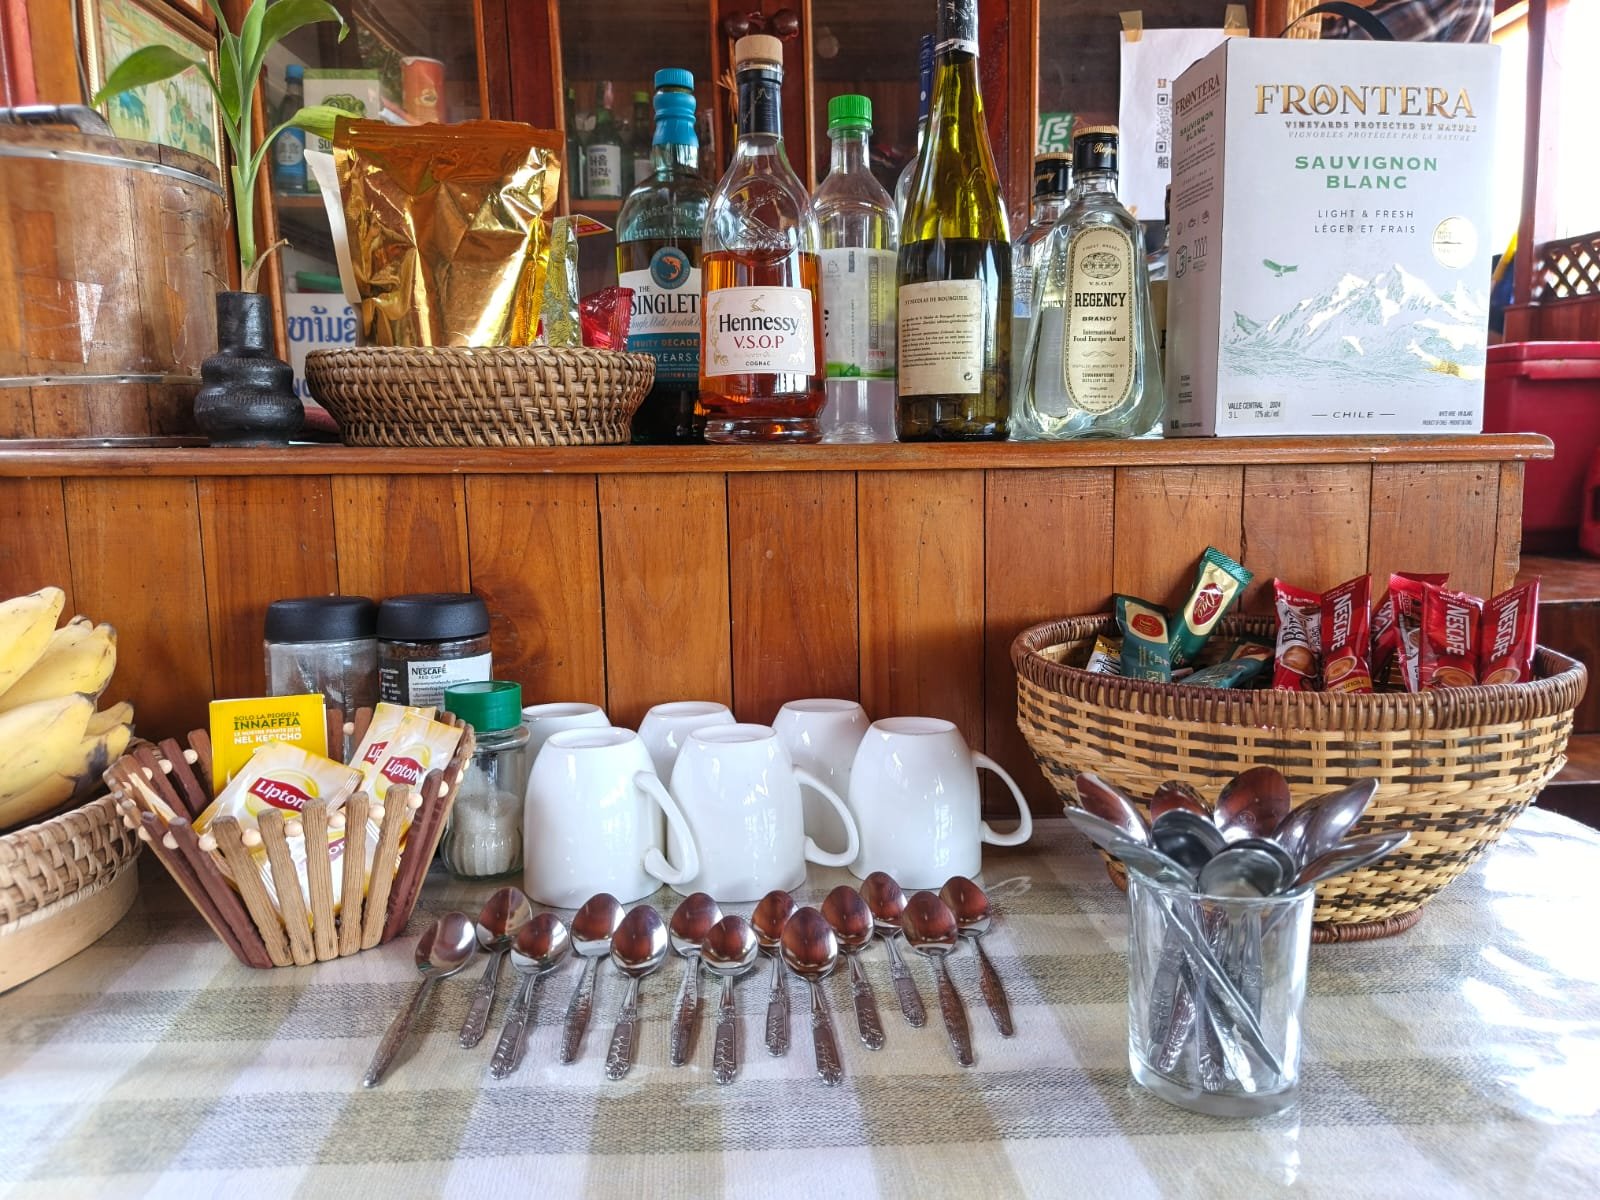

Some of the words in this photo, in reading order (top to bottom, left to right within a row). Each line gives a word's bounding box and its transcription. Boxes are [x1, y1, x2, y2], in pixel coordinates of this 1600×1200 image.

[1175, 73, 1220, 115] FRONTERA
[1254, 84, 1477, 119] FRONTERA
[1285, 121, 1349, 129] VINEYARDS
[1354, 121, 1415, 130] PROTECTED
[1421, 122, 1433, 131] BY
[1288, 131, 1344, 139] VIGNOBLES
[1295, 155, 1438, 171] SAUVIGNON
[1326, 175, 1407, 189] BLANC
[1318, 209, 1355, 218] LIGHT
[1362, 209, 1369, 218] &
[1375, 209, 1414, 218] FRESH
[1314, 223, 1354, 233] LÉGER
[1361, 225, 1374, 233] ET
[1380, 225, 1416, 234] FRAIS
[639, 285, 650, 293] THE
[1074, 292, 1127, 308] REGENCY
[719, 313, 799, 335] Hennessy
[733, 334, 785, 349] V.S.O.P
[1088, 335, 1107, 344] Europe
[656, 353, 692, 362] YEARS
[1242, 401, 1263, 409] CENTRAL
[1228, 411, 1233, 419] 3
[1332, 411, 1375, 419] CHILE
[411, 664, 447, 675] NESCAFÉ
[234, 717, 301, 730] INNAFFIA
[234, 736, 254, 745] NEL
[385, 759, 419, 781] Lipton
[255, 779, 307, 810] Lipton
